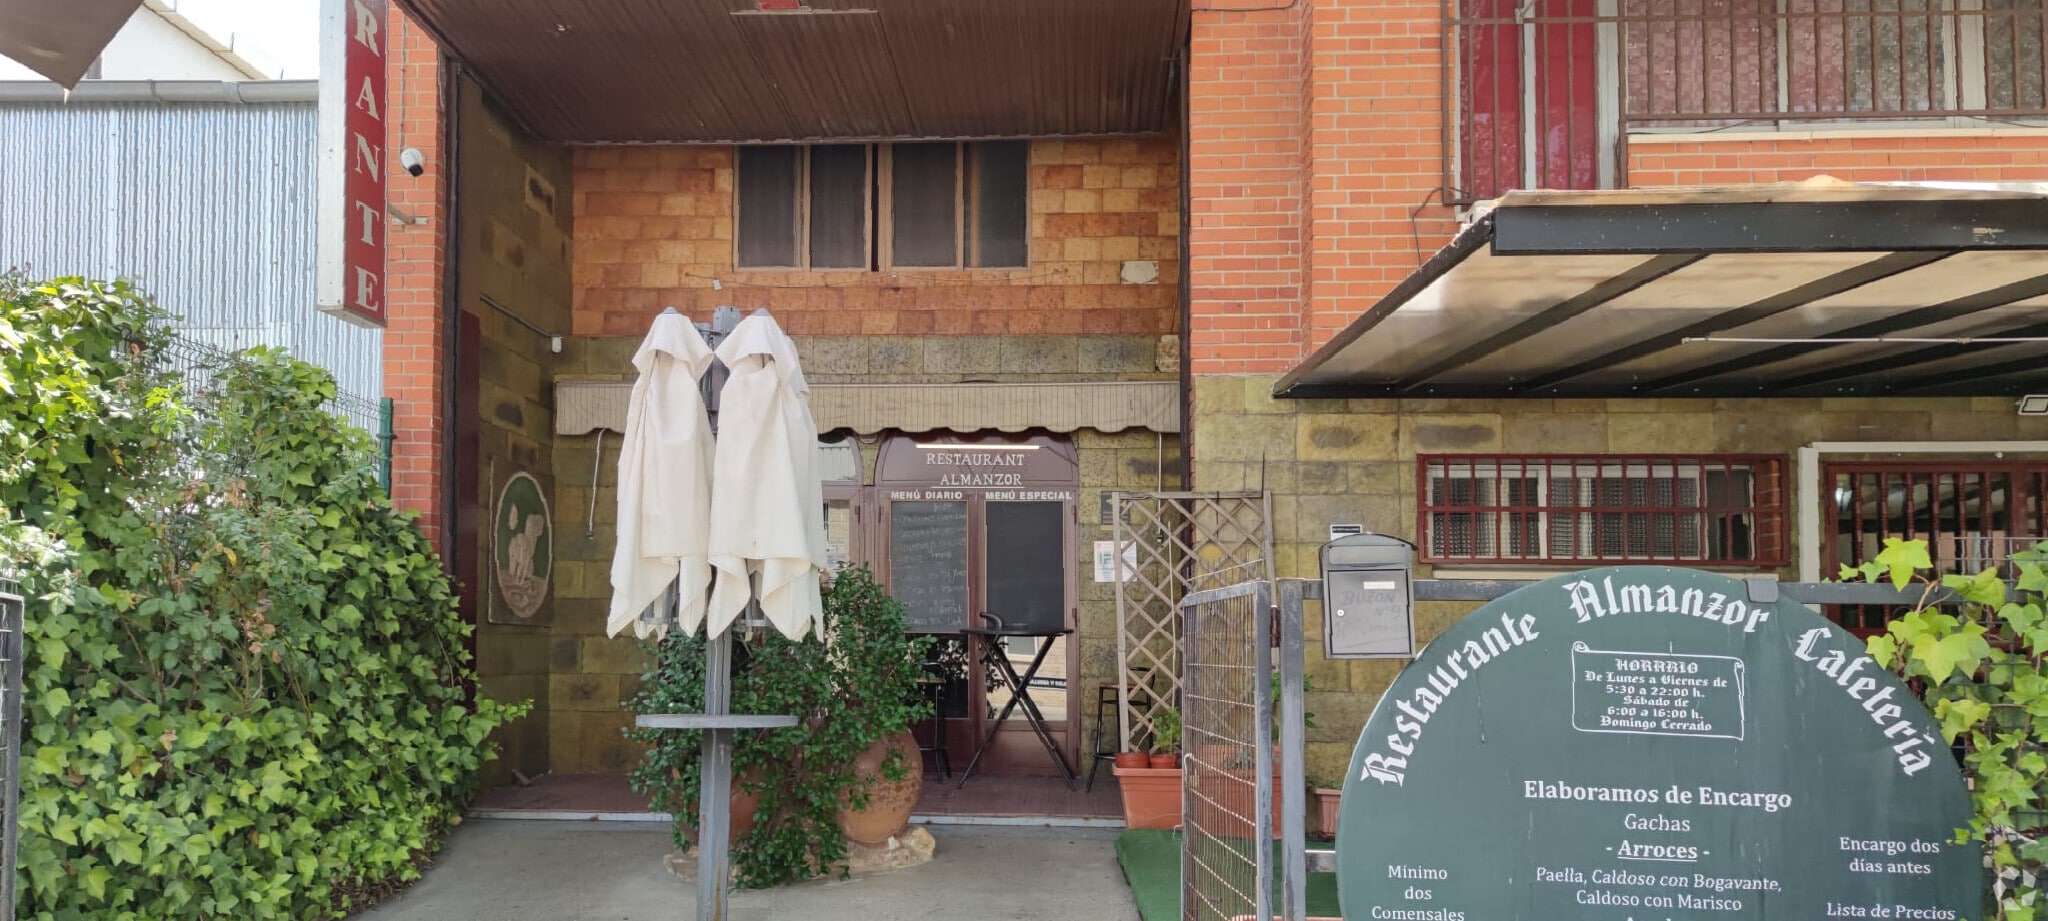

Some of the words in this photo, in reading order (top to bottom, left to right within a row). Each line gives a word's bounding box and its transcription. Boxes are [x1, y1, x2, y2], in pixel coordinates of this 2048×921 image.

[353, 0, 381, 313] RANTE
[926, 452, 1025, 467] RESTAURANT
[940, 473, 1023, 487] ALMANZOR
[890, 490, 921, 500] MENÚ
[925, 491, 963, 500] DIARIO
[985, 490, 1016, 500] MENÚ
[1019, 491, 1072, 500] ESPECIAL
[1360, 611, 1540, 788] Restaurante
[1561, 575, 1770, 634] Almanzor
[1794, 627, 1936, 777] Cafetería
[1585, 671, 1602, 682] De
[1606, 671, 1645, 684] Lunes
[1649, 676, 1656, 684] a
[1660, 673, 1708, 687] Viernes
[1713, 676, 1728, 688] de
[1605, 685, 1635, 695] 5:30
[1639, 687, 1647, 695] a
[1650, 686, 1689, 697] 22:00
[1692, 687, 1706, 698] h.
[1623, 695, 1670, 706] Sábado
[1674, 696, 1690, 707] de
[1607, 706, 1636, 717] 6:00
[1640, 709, 1649, 717] a
[1653, 708, 1688, 719] 16:00
[1691, 708, 1704, 720] h.
[1600, 715, 1657, 730] Domingo
[1661, 718, 1712, 731] Cerrado
[1523, 779, 1660, 803] Elaboramos
[1664, 785, 1693, 804] de
[1698, 786, 1793, 813] Encargo
[1624, 813, 1691, 832] Gachas
[1617, 839, 1698, 862] Arroces
[1839, 836, 1906, 855] Encargo
[1910, 838, 1940, 854] dos
[1387, 864, 1449, 880] Mínimo
[1849, 858, 1883, 873] días
[1887, 860, 1931, 875] antes
[1536, 866, 1588, 886] Paella,
[1591, 868, 1656, 887] Caldoso
[1659, 873, 1689, 888] con
[1693, 873, 1783, 893] Bogavante,
[1404, 885, 1433, 900] dos
[1576, 889, 1640, 907] Caldoso
[1644, 894, 1673, 908] con
[1677, 893, 1743, 911] Marisco
[1371, 905, 1466, 921] Comensales
[1826, 902, 1866, 918] Lista
[1870, 904, 1891, 919] de
[1895, 904, 1956, 921] Precios
